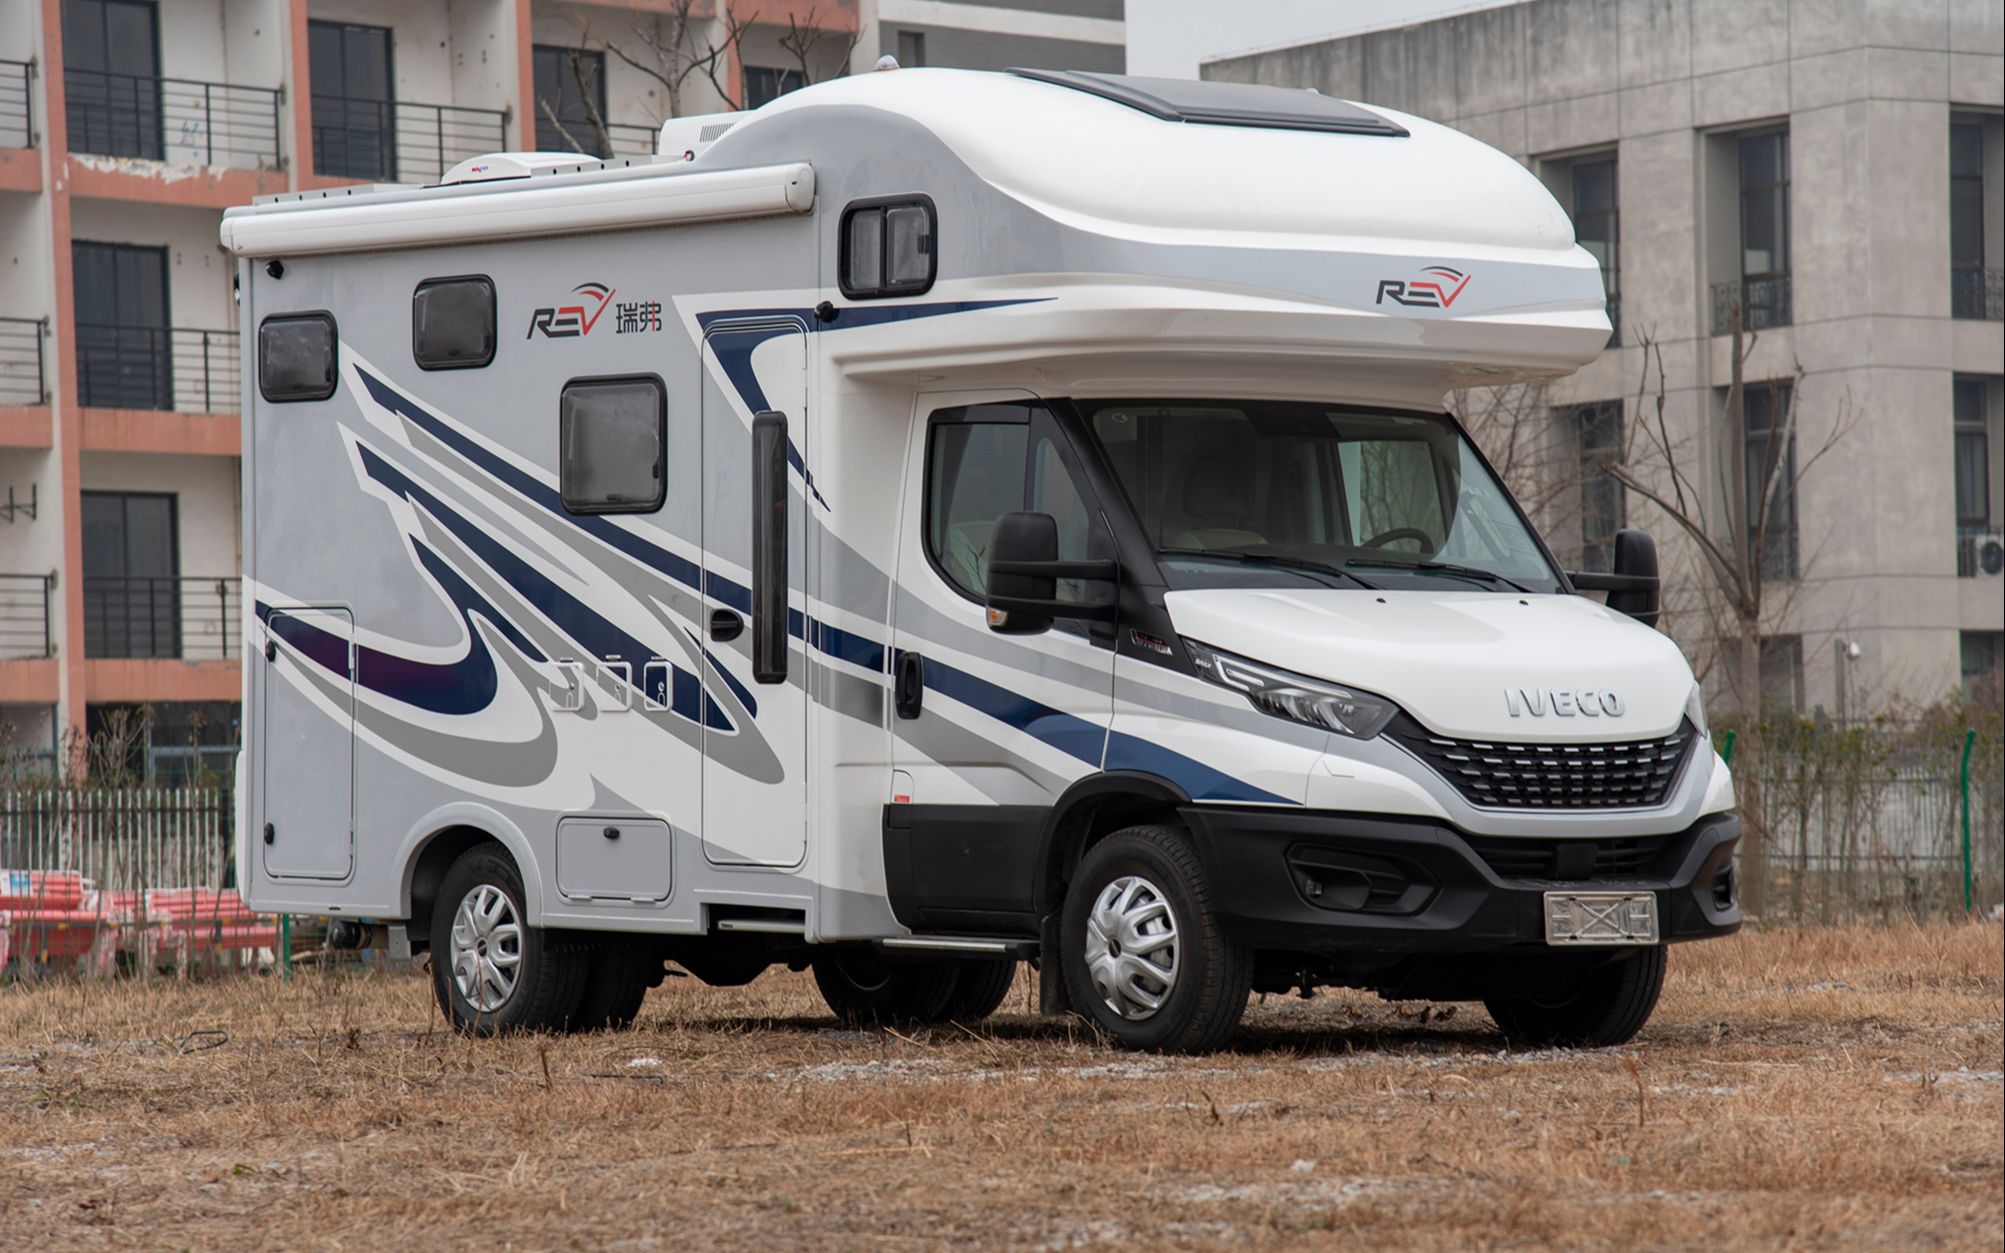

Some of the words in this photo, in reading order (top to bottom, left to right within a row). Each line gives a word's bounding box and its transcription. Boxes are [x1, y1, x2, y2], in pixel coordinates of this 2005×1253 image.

[1376, 274, 1471, 309] REV
[526, 287, 617, 340] REV
[1503, 687, 1626, 718] IVECO
